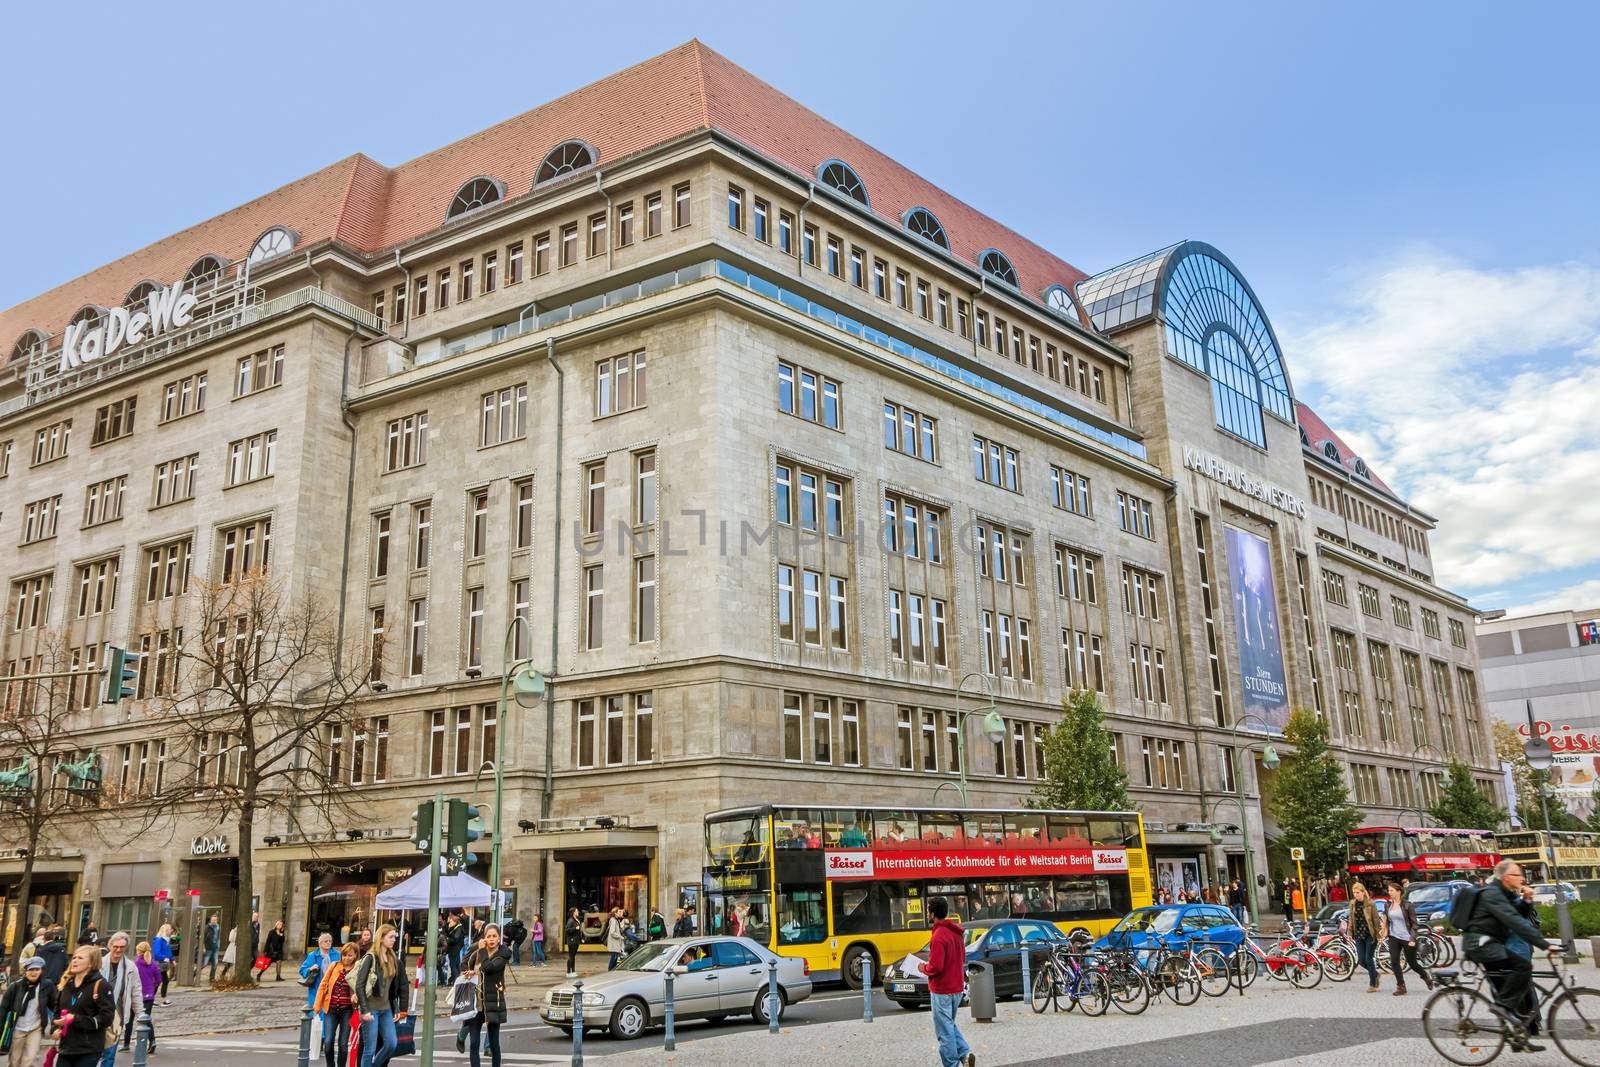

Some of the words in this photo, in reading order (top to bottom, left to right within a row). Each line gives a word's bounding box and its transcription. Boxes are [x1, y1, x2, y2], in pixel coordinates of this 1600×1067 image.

[59, 281, 199, 372] KaDeWe
[1182, 445, 1248, 493] KAUFHAUS
[1261, 482, 1306, 519] WESTENS
[1245, 676, 1284, 696] STUNDEN
[190, 835, 227, 854] KaDeWe
[829, 856, 867, 869] Leiser
[876, 856, 942, 869] Internationale
[945, 856, 996, 867] Schuhmode
[998, 855, 1011, 866] für
[1013, 855, 1027, 866] die
[1029, 855, 1068, 866] Weltstadt
[1070, 854, 1092, 865] Berlin
[1097, 853, 1124, 864] Leiser
